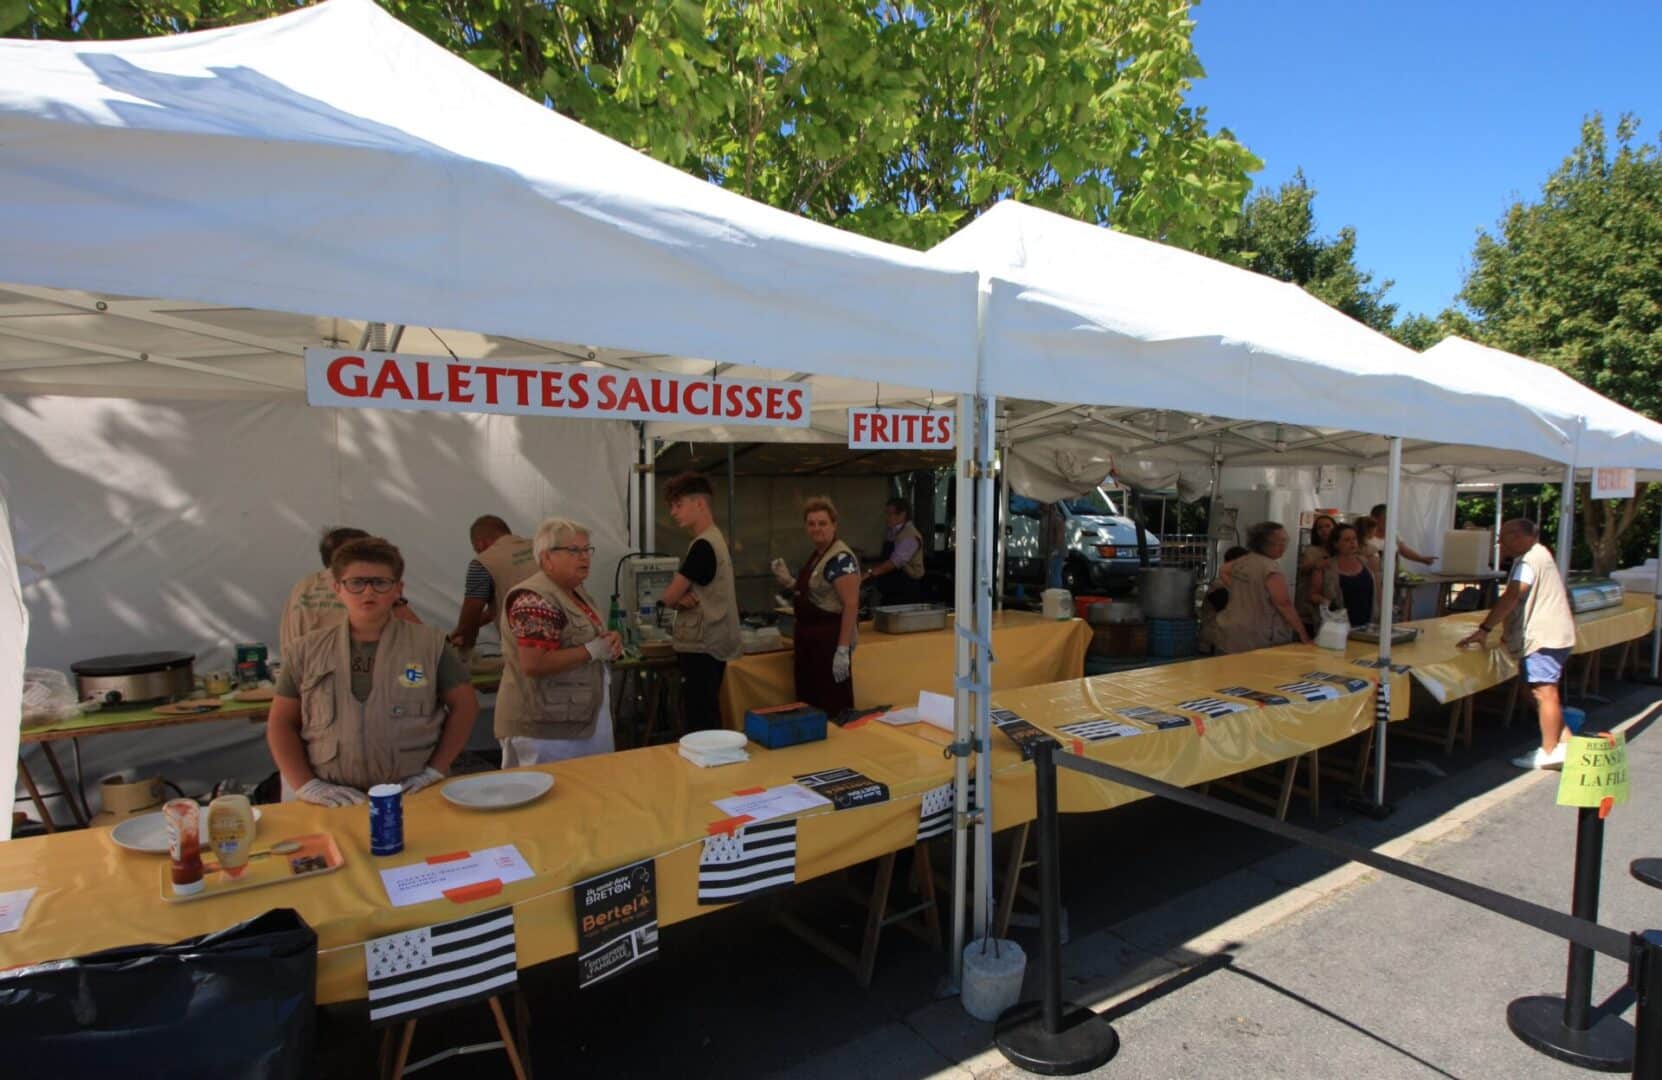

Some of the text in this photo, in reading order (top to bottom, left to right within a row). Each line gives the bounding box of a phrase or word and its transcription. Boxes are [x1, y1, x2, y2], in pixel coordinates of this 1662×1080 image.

[326, 355, 804, 421] GALETTES SAUCISSES
[853, 412, 951, 444] FRITES
[1579, 773, 1602, 787] LA
[585, 881, 632, 906] BRETON
[583, 898, 638, 932] Bertel
